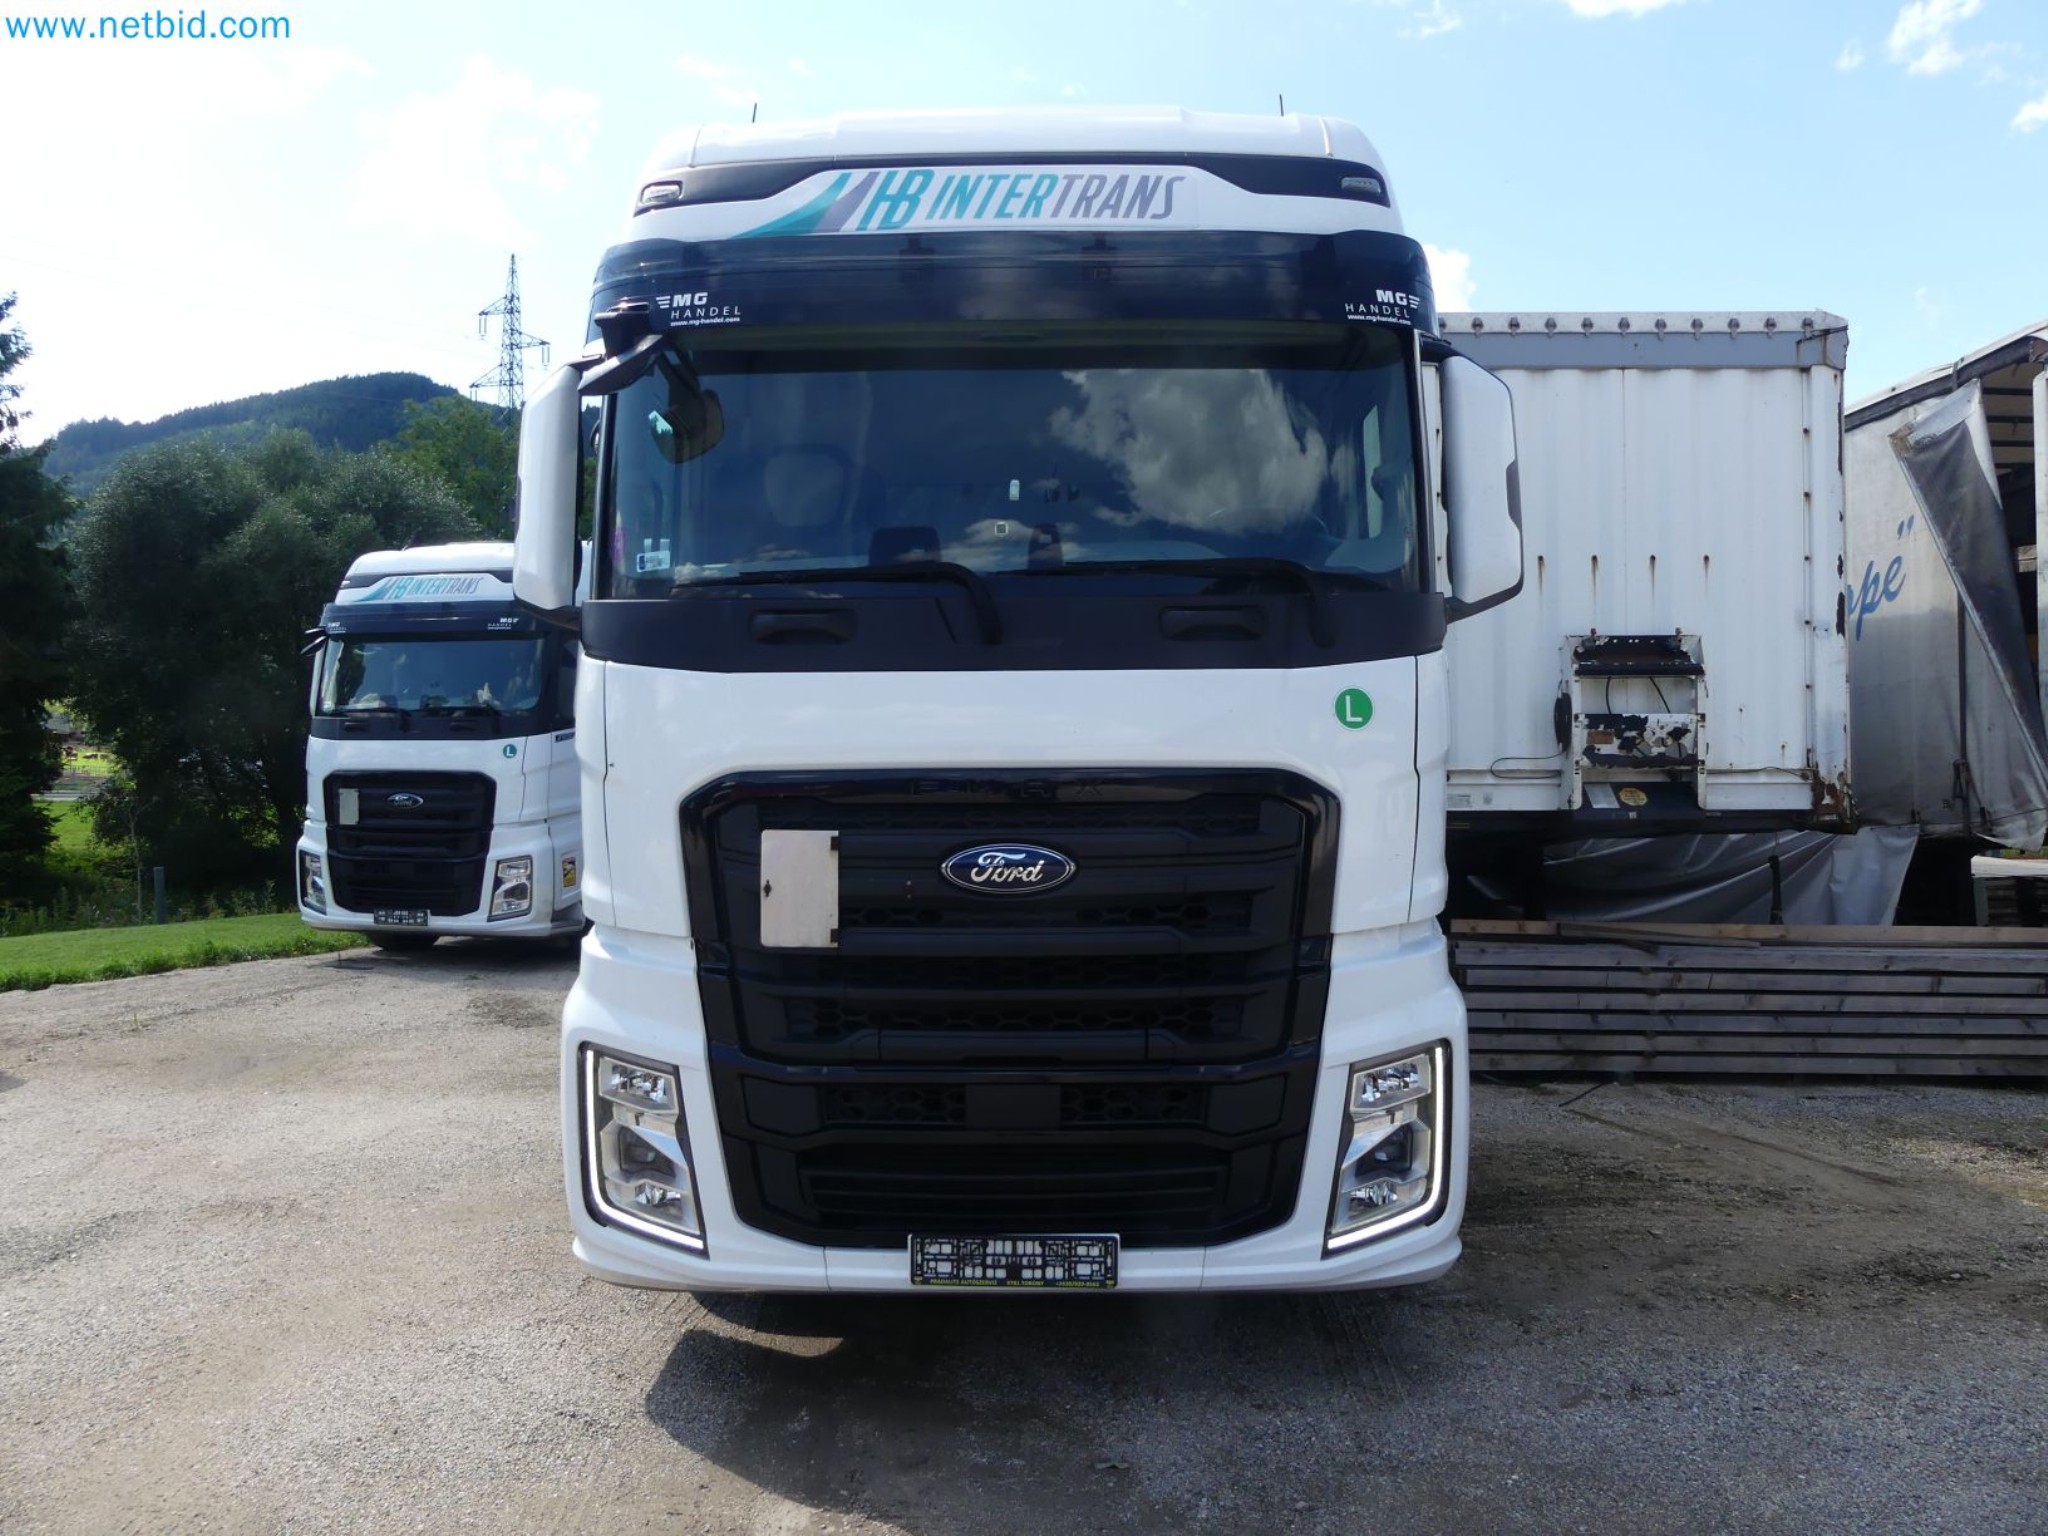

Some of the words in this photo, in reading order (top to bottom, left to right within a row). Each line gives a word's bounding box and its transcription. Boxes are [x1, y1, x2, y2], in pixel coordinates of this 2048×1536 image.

[855, 168, 935, 232] HB
[924, 173, 1186, 220] INTERTRANS
[672, 292, 708, 307] MG
[1376, 289, 1408, 306] MG
[670, 305, 741, 319] HANDEL
[1344, 303, 1410, 318] HANDEL
[405, 576, 484, 595] INTERTRANS
[1345, 695, 1363, 722] L
[506, 746, 514, 757] L
[971, 852, 1045, 883] Ford
